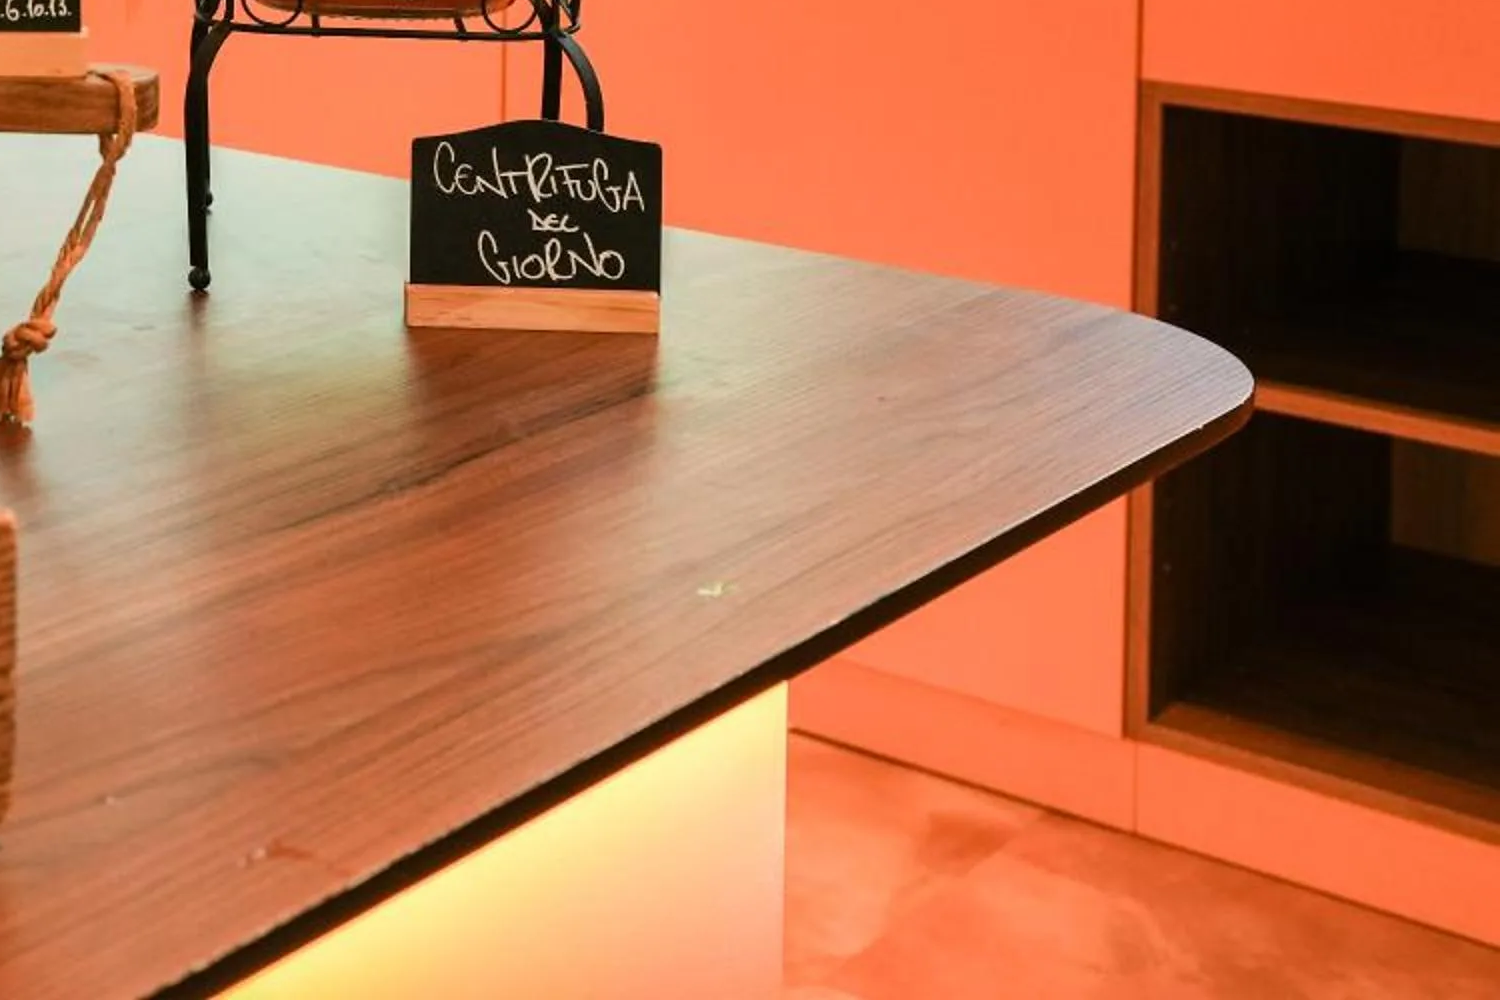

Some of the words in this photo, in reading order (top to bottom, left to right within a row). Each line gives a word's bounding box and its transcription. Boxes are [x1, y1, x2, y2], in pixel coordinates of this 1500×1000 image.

[433, 141, 645, 213] CENTRIFUGA
[526, 208, 580, 233] DEL
[477, 230, 626, 285] GIORNO
